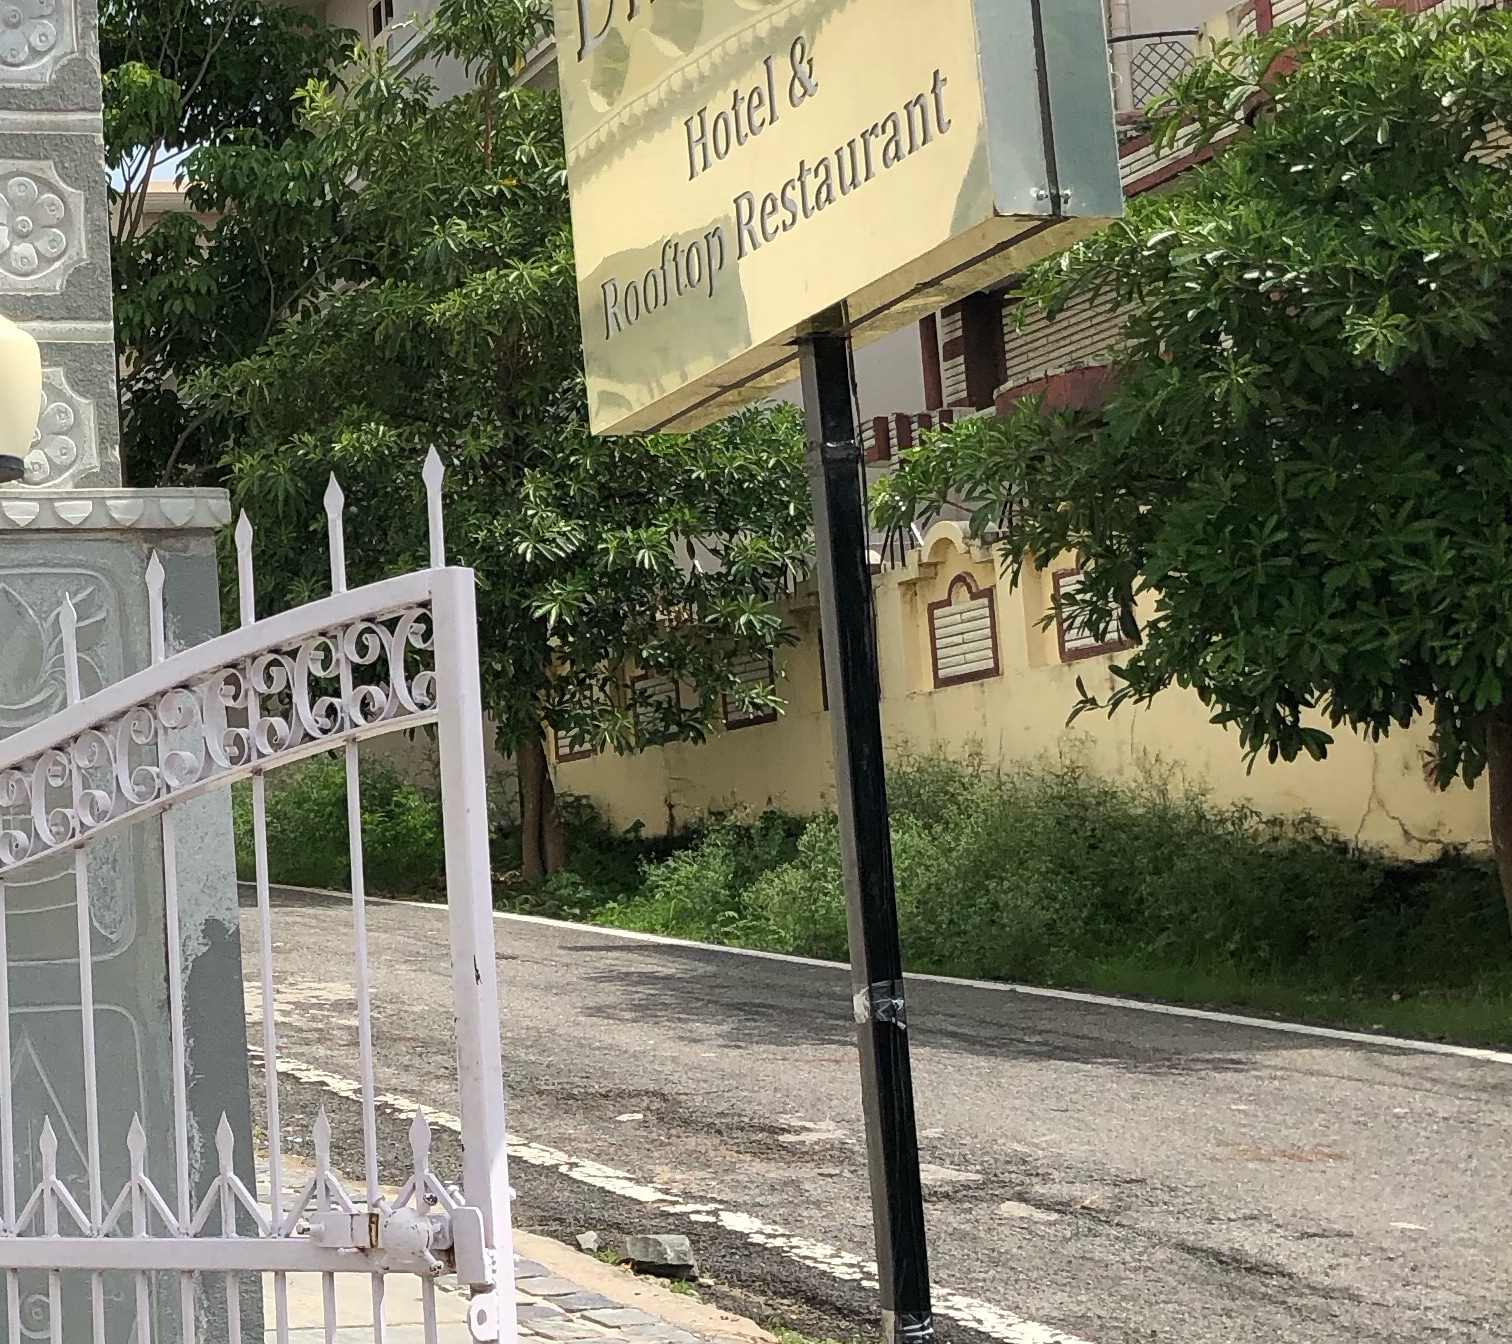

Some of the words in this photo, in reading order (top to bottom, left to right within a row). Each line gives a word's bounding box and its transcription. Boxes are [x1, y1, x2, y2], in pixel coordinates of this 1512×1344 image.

[600, 226, 724, 341] Rooftop
[732, 68, 952, 261] Restaurant
[683, 55, 779, 182] Hotel
[788, 35, 819, 108] &
